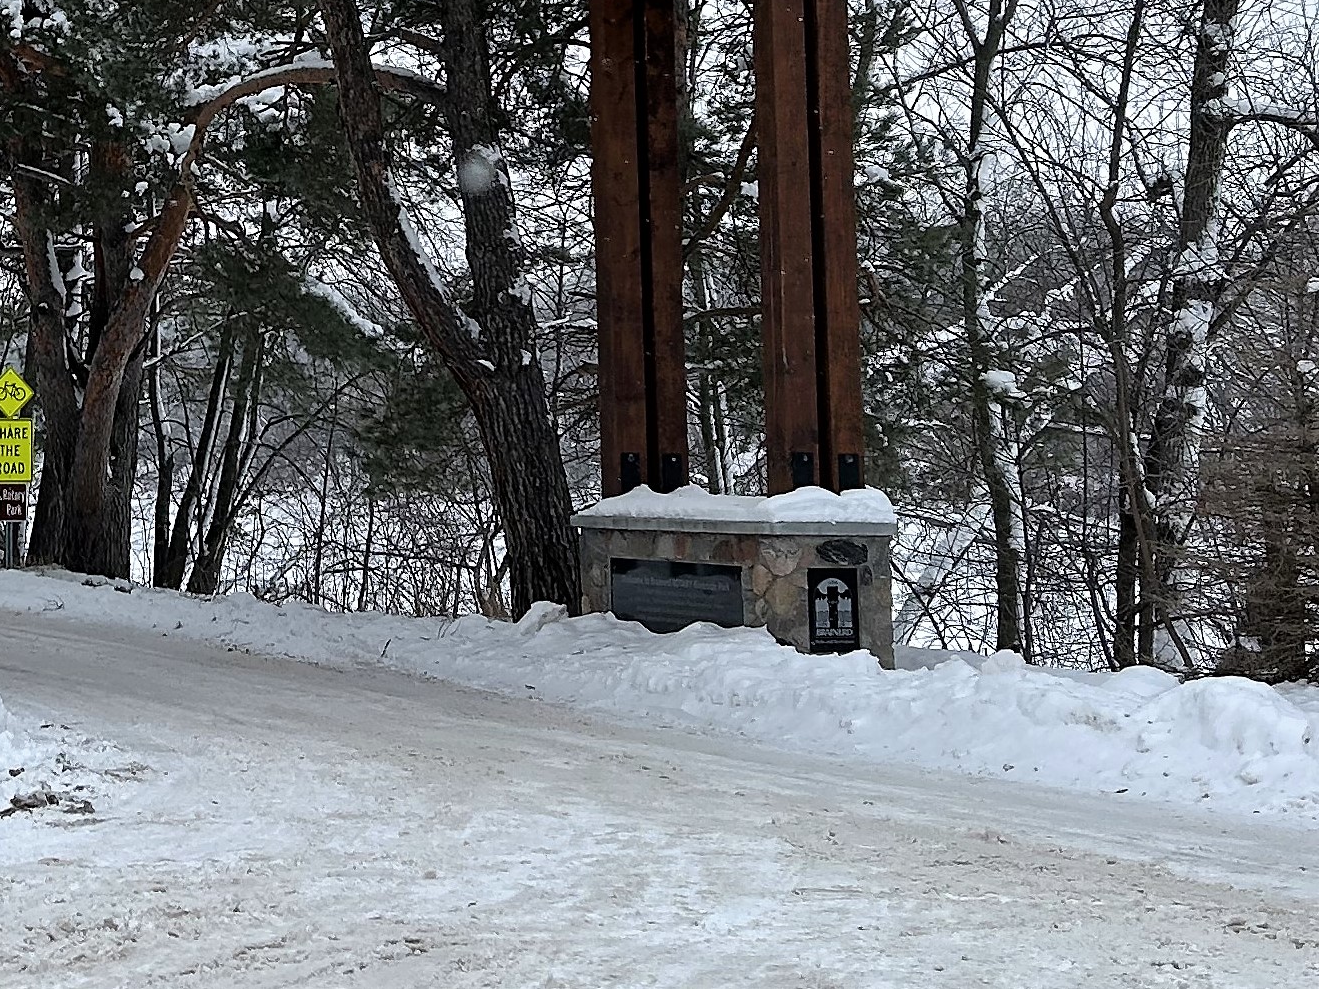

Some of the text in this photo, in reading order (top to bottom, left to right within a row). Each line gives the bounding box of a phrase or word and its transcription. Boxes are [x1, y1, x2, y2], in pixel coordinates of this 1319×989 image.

[0, 444, 21, 457] THE
[2, 488, 26, 503] Rotary
[6, 503, 22, 516] Park
